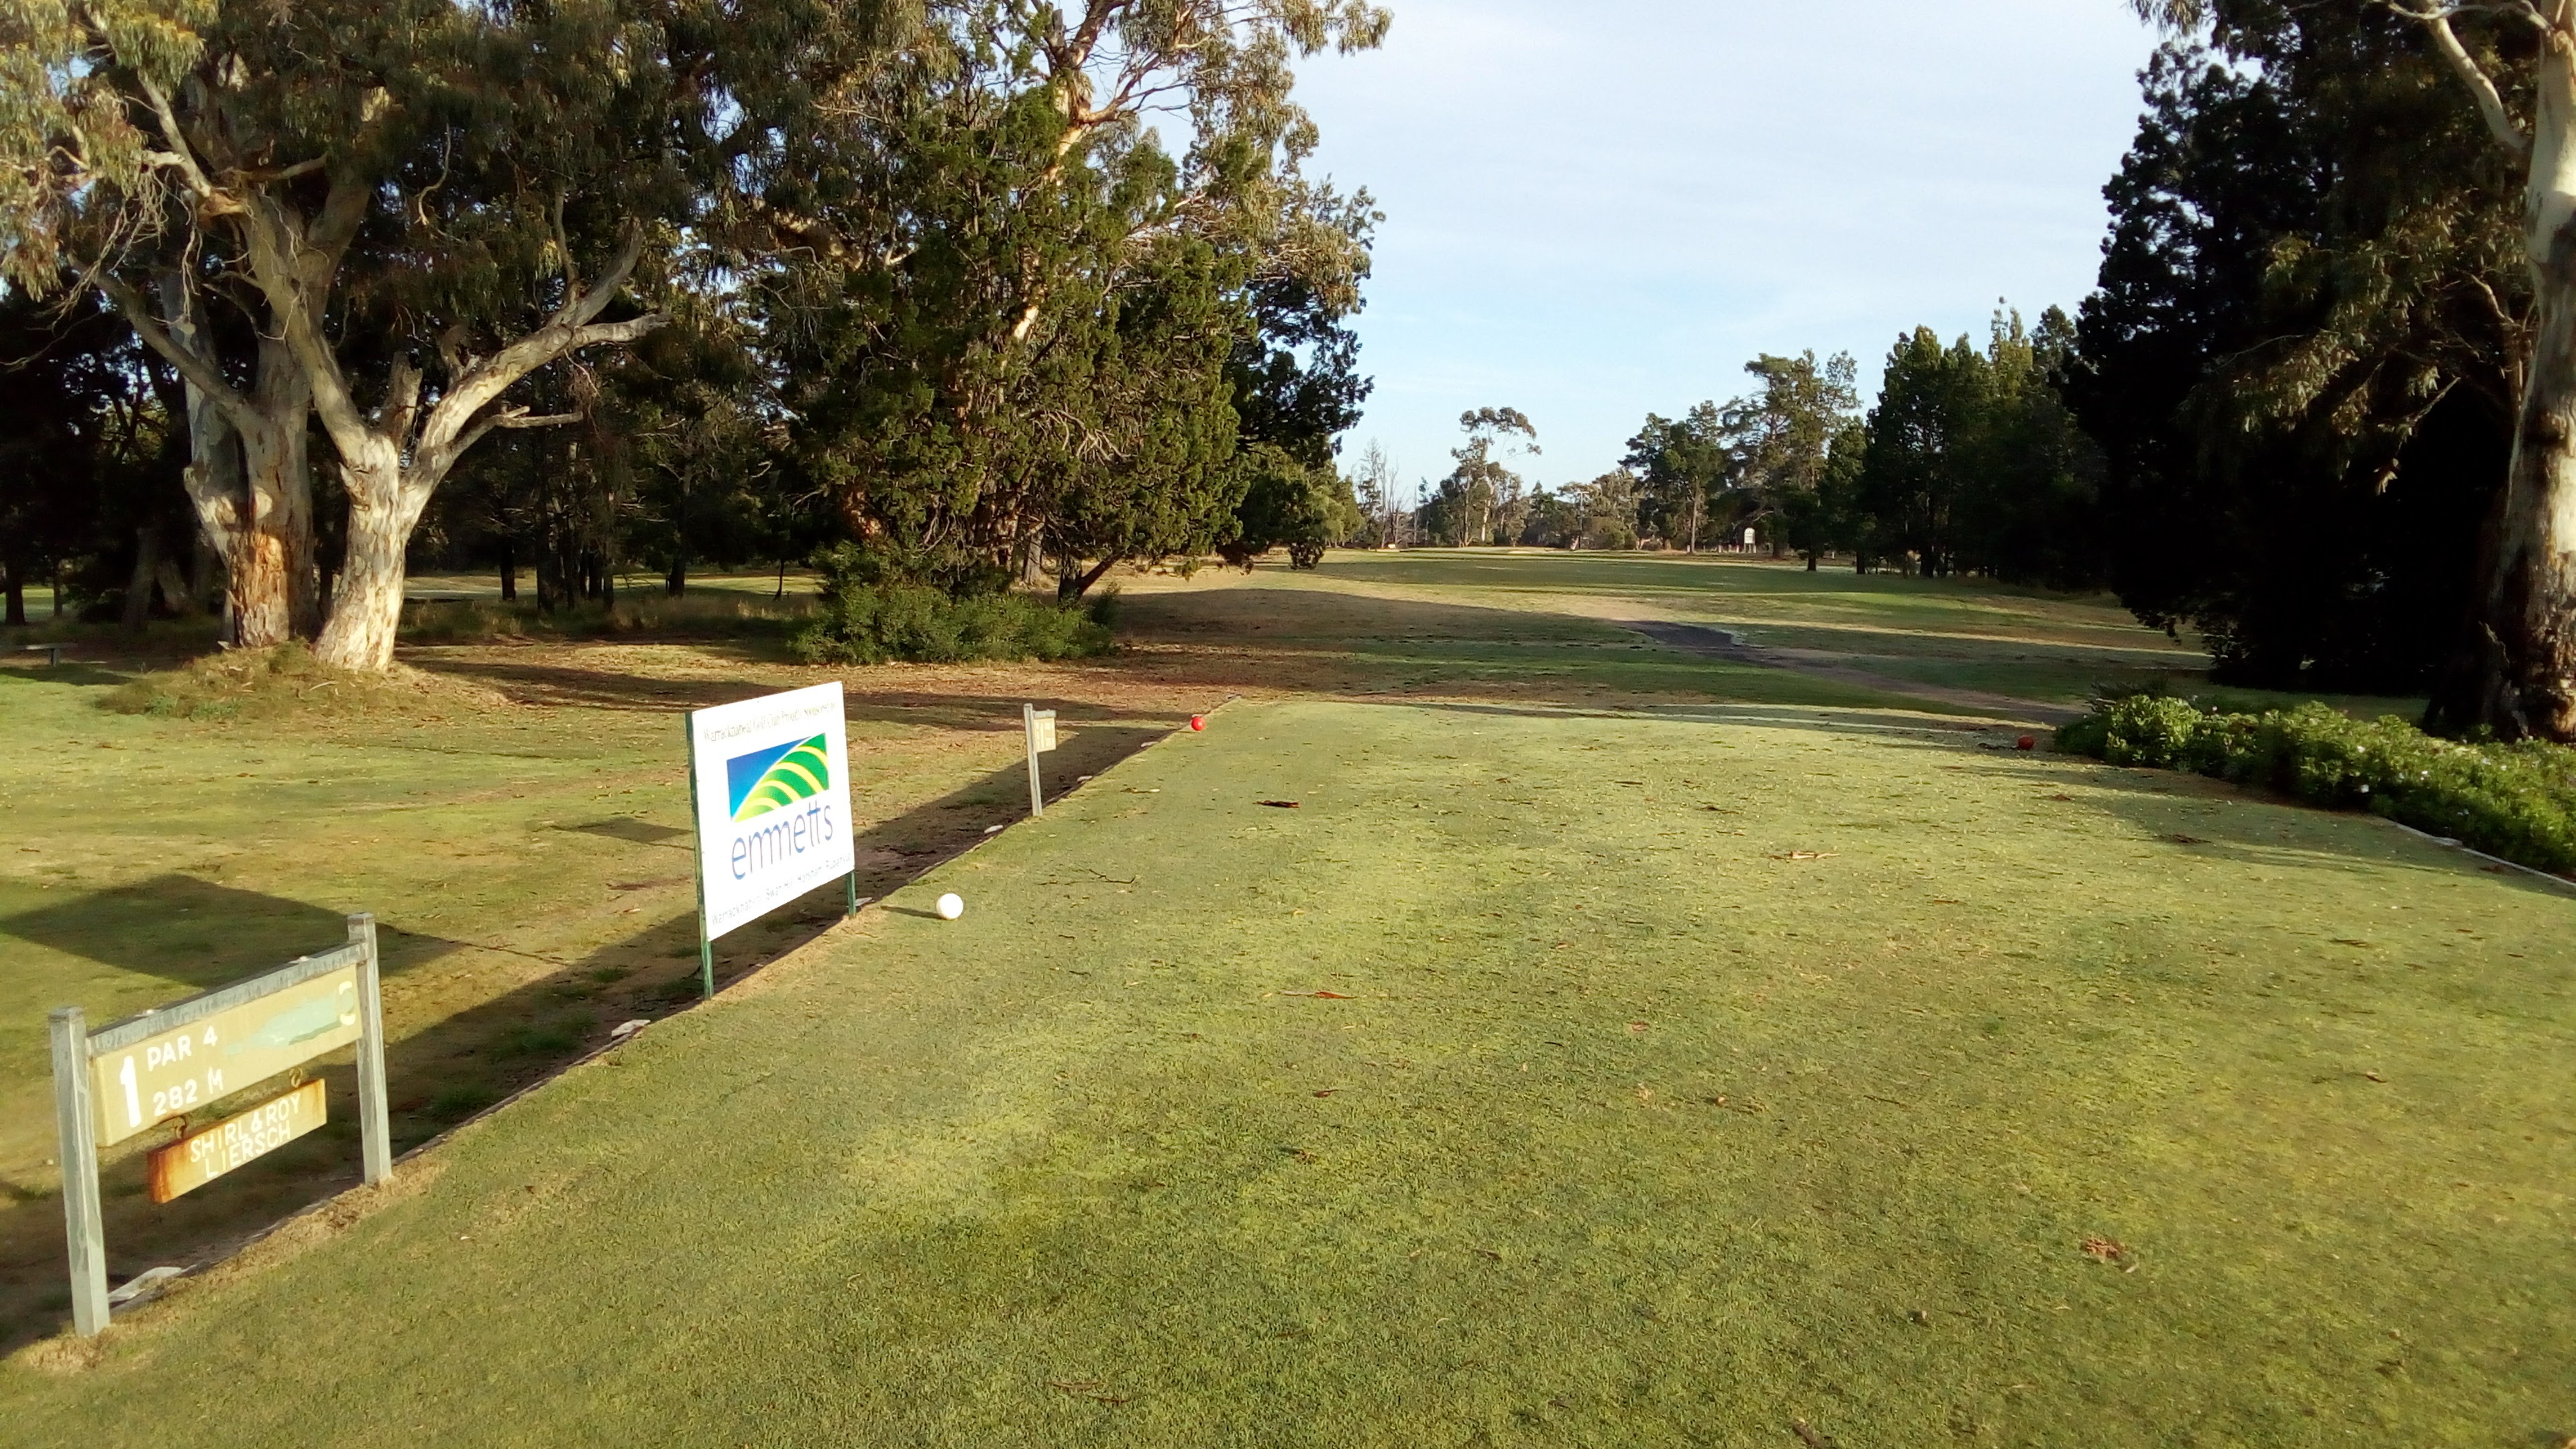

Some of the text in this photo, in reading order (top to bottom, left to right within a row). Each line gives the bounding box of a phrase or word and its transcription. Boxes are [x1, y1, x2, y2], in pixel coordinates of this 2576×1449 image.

[732, 799, 833, 881] emmetts
[147, 1025, 218, 1071] PAR 4
[119, 1055, 142, 1128] 1
[153, 1066, 223, 1116] 282 M
[191, 1119, 249, 1162] SHIRL
[266, 1093, 301, 1127] ROY
[205, 1120, 290, 1179] LIERSCH
